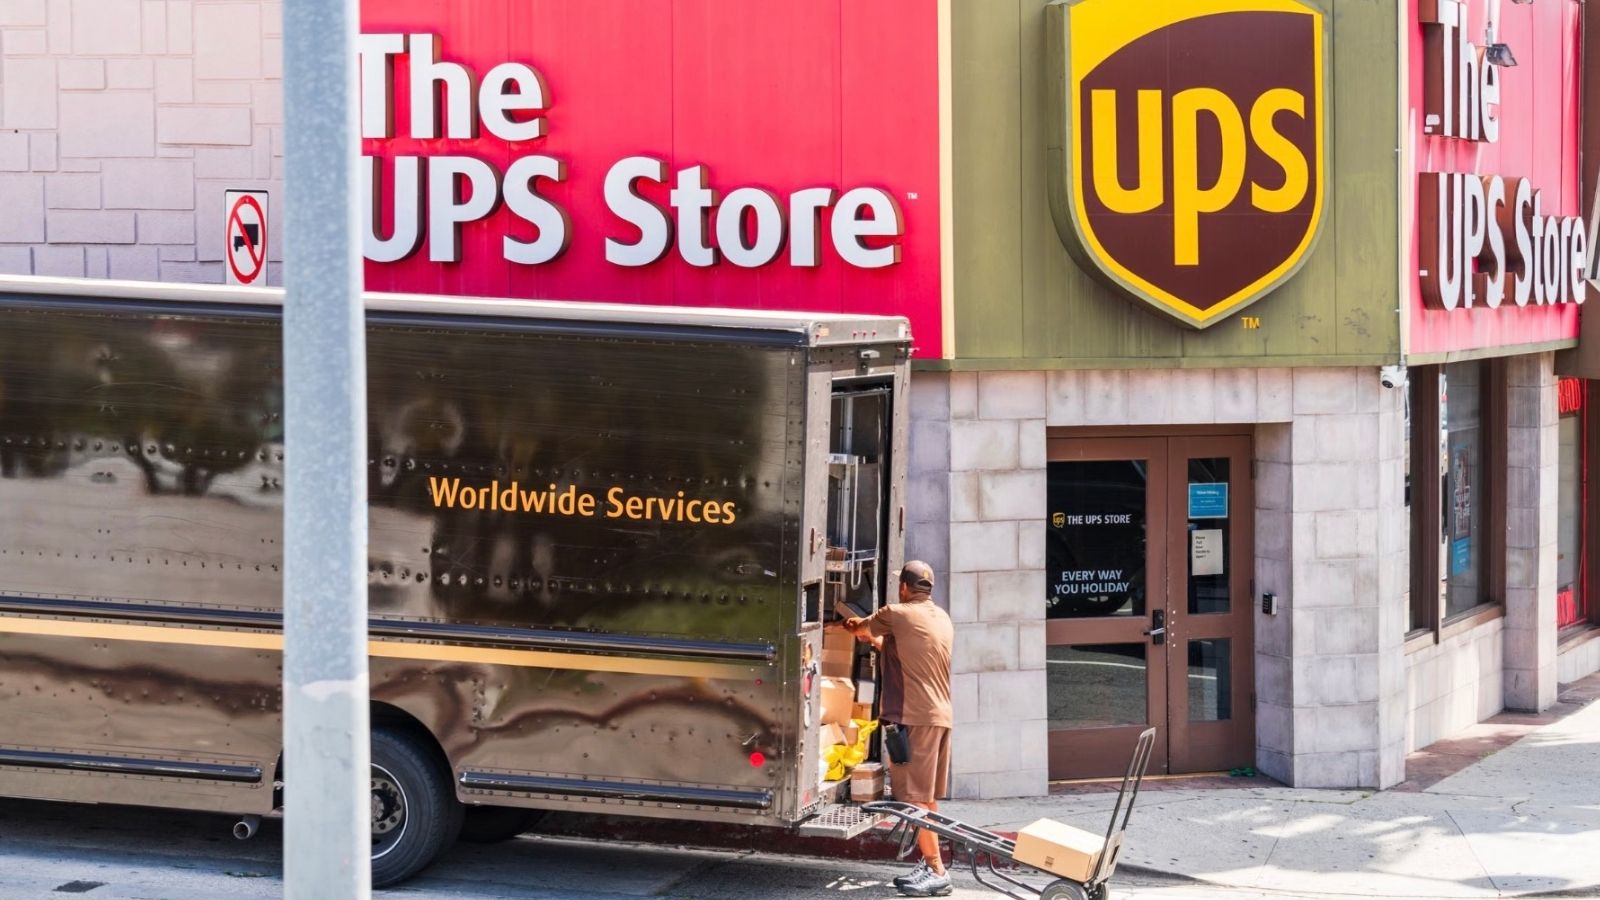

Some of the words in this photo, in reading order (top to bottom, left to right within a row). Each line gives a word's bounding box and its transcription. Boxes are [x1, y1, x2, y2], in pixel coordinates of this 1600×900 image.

[358, 33, 545, 141] The
[1438, 0, 1500, 143] The
[361, 154, 567, 265] UPS
[604, 156, 899, 267] Store
[1091, 87, 1309, 266] ups
[1438, 172, 1506, 311] UPS
[1515, 177, 1587, 307] Store
[1240, 316, 1261, 329] TM
[430, 477, 596, 516] Worldwide
[606, 487, 736, 525] Services
[1067, 515, 1083, 525] THE
[1085, 515, 1102, 524] UPS
[1104, 514, 1131, 524] STORE
[1055, 584, 1079, 594] YOU
[1081, 582, 1130, 593] HOLIDAY
[1062, 570, 1095, 582] EVERY
[1097, 570, 1123, 580] WAY
